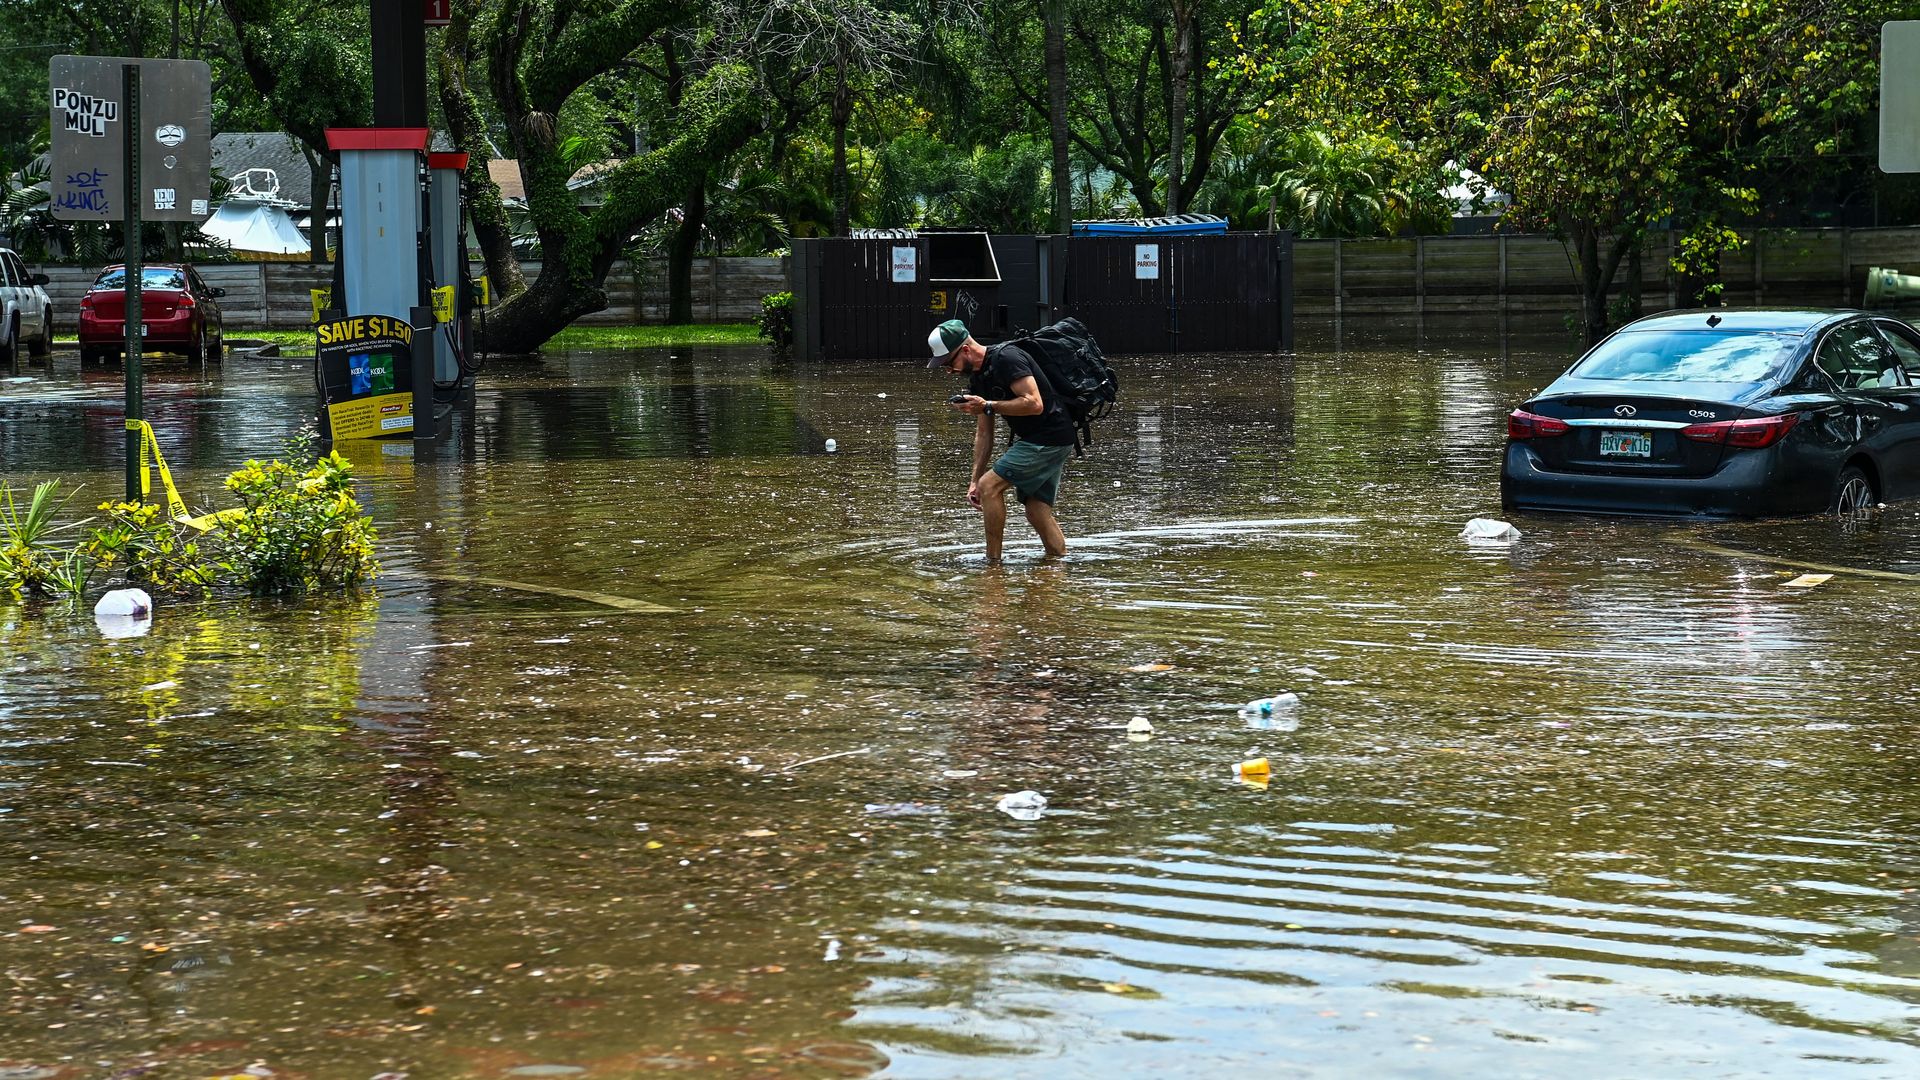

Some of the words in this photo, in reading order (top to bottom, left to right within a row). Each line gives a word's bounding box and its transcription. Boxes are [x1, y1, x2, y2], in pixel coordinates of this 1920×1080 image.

[433, 0, 440, 17] 1
[56, 90, 116, 120] PONZU
[66, 112, 103, 136] MUL
[318, 318, 364, 344] SAVE
[369, 316, 411, 344] $1.50
[1689, 409, 1715, 419] Q50S
[1632, 438, 1650, 452] K16
